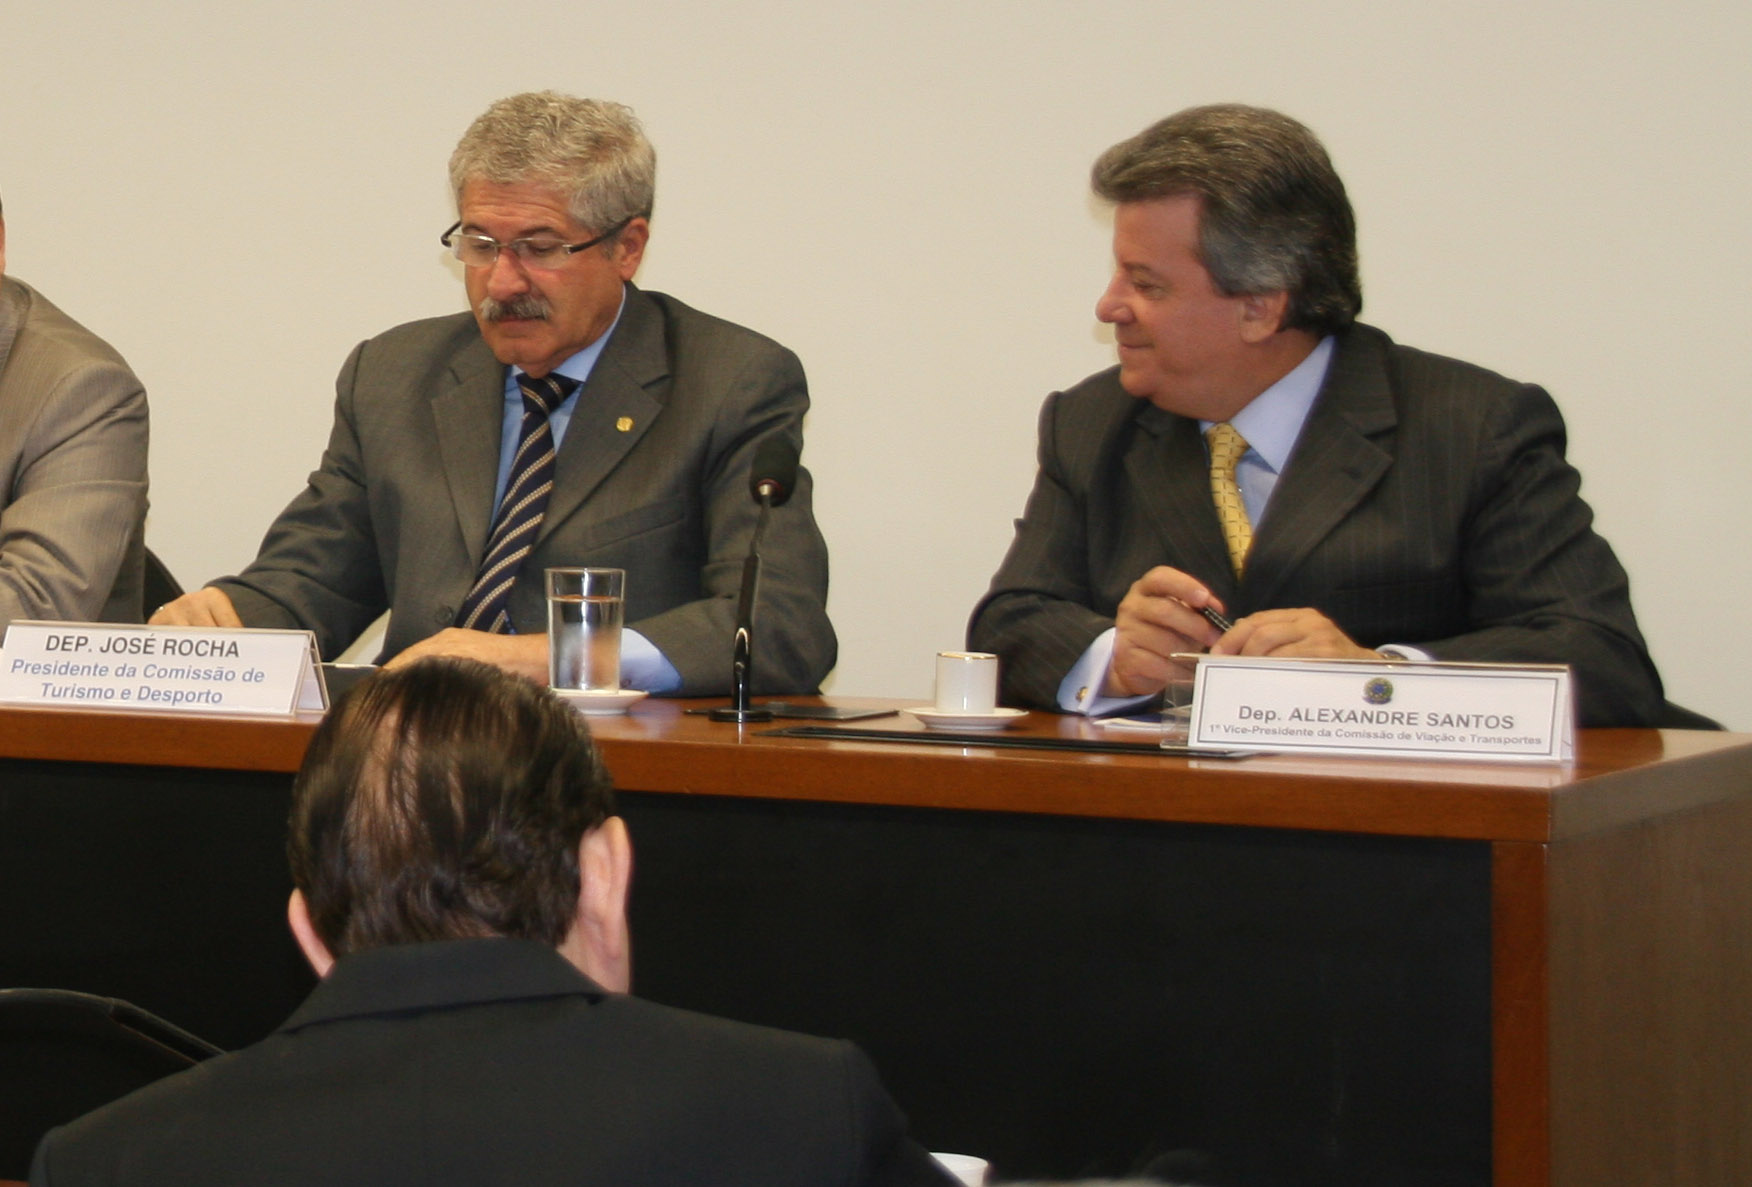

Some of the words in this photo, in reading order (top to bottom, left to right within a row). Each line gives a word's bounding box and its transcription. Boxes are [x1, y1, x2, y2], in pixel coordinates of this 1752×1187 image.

[45, 634, 93, 652] DEP.
[100, 633, 156, 655] JOSÉ
[162, 638, 240, 658] ROCHA
[11, 659, 109, 677] Presidente
[114, 663, 136, 678] da
[143, 664, 236, 682] Comissão
[242, 667, 264, 683] de
[40, 683, 115, 701] Turismo
[121, 689, 131, 700] e
[138, 686, 222, 706] Desporto
[1238, 706, 1281, 722] Dep.
[1288, 707, 1419, 727] ALEXANDRE
[1426, 712, 1514, 730] SANTOS
[1224, 725, 1314, 737] Vice-Presidente
[1317, 728, 1332, 738] da
[1335, 729, 1395, 740] Comissão
[1397, 731, 1412, 740] de
[1415, 731, 1456, 744] Viação
[1470, 734, 1542, 746] Transportes
